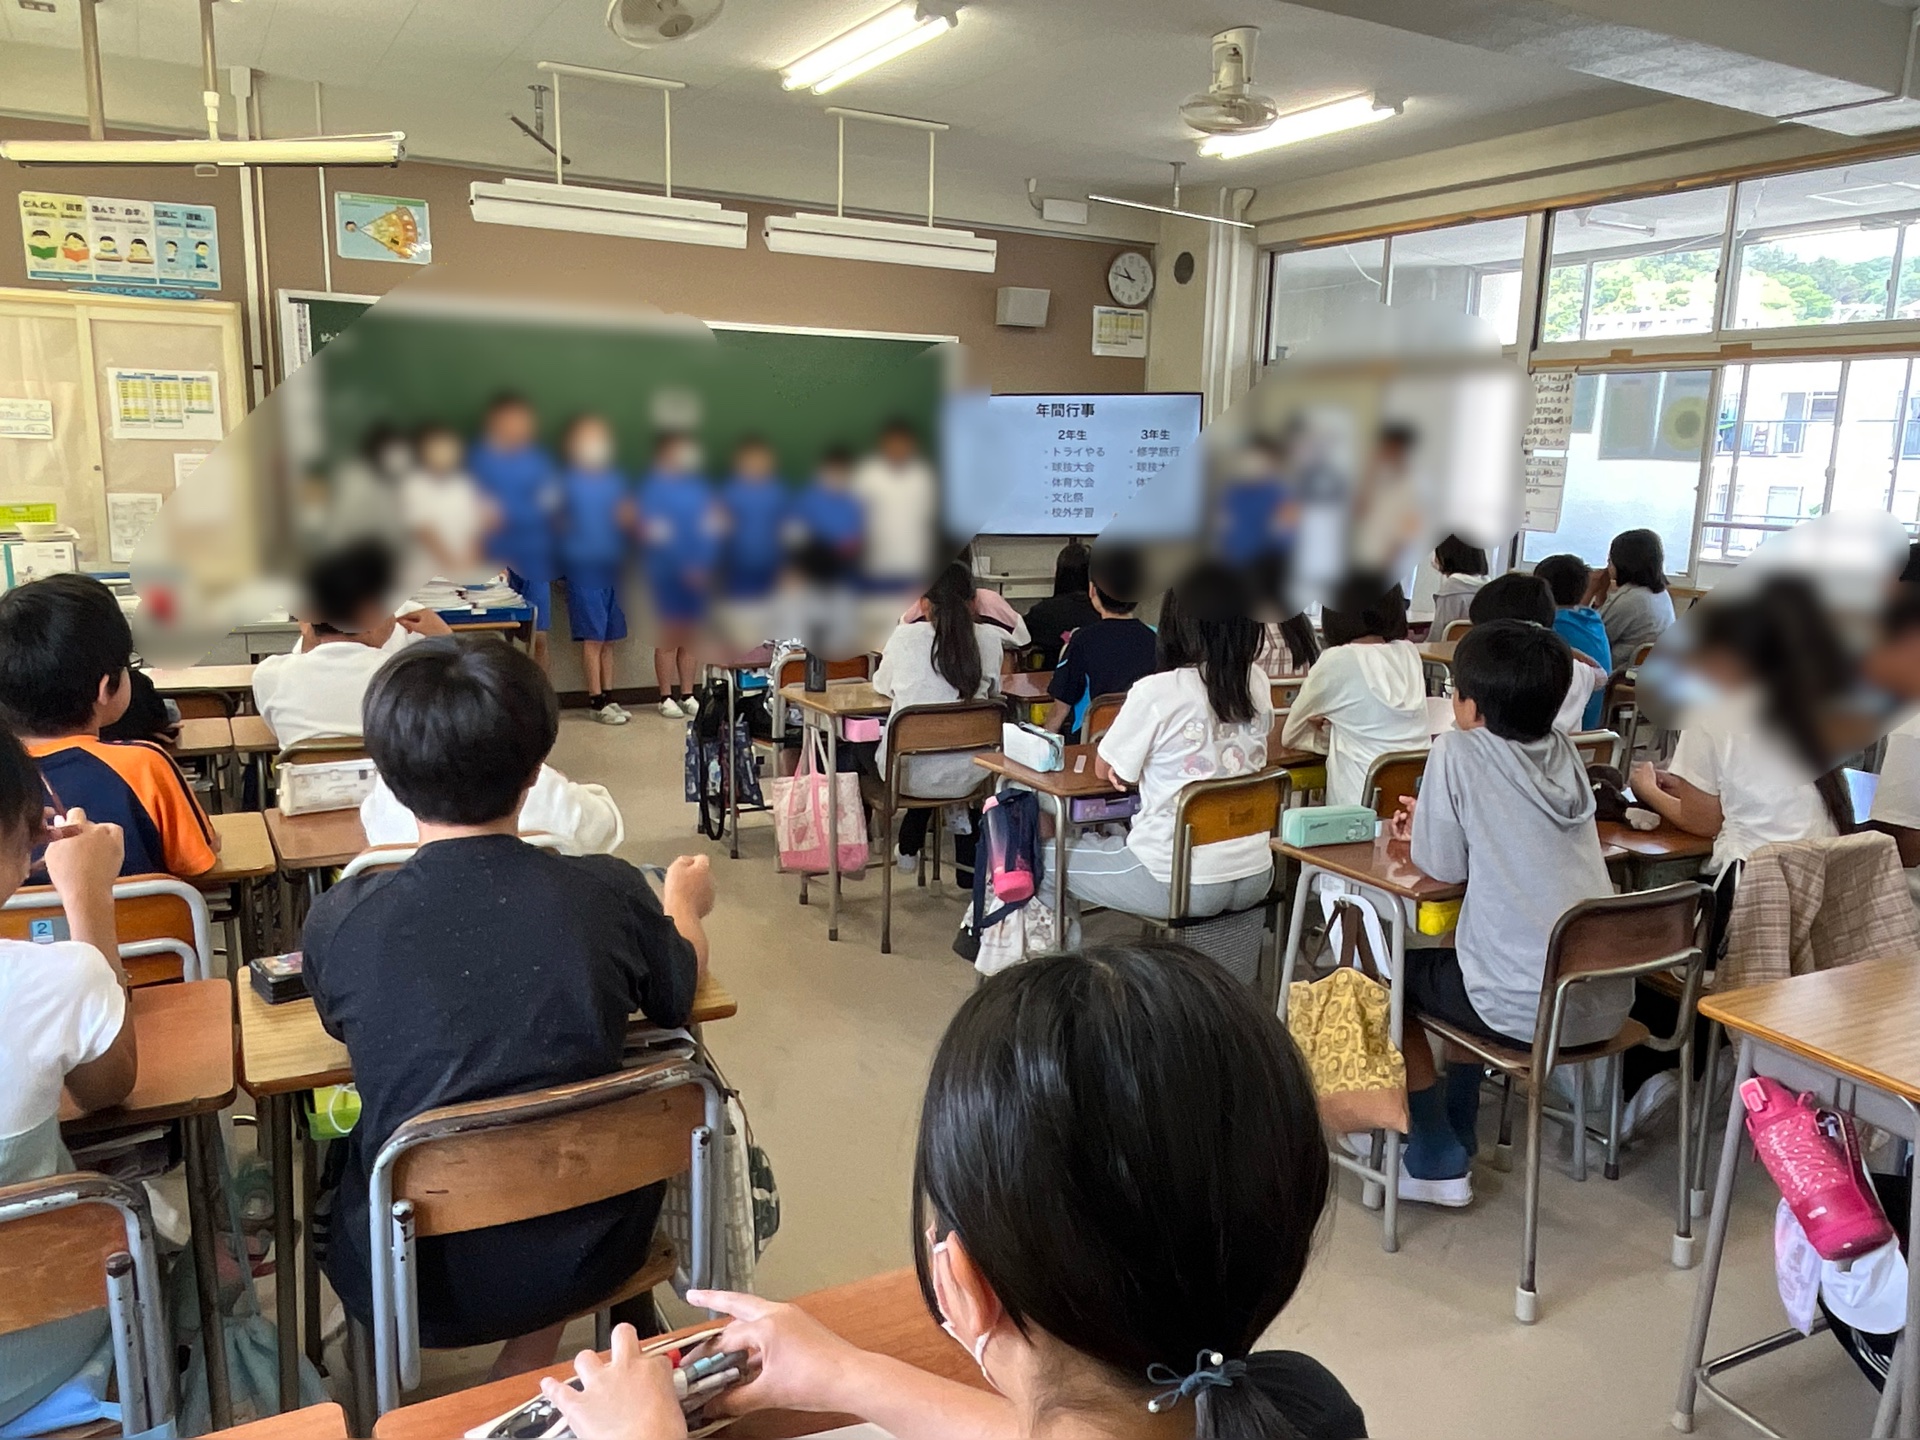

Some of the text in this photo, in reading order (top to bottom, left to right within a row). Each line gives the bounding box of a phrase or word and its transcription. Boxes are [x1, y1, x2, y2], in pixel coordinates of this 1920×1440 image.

[1036, 403, 1095, 418] 年間行事
[1058, 429, 1087, 440] 2年生
[1140, 429, 1170, 440] 3年生
[1053, 447, 1105, 457] トライやる
[1136, 446, 1180, 457] 修学旅行
[1052, 462, 1095, 472] 球技大会
[1052, 477, 1095, 488] 体育大会
[1052, 493, 1084, 503] 文化祭
[1052, 507, 1095, 518] 校外学習
[37, 922, 48, 934] 2
